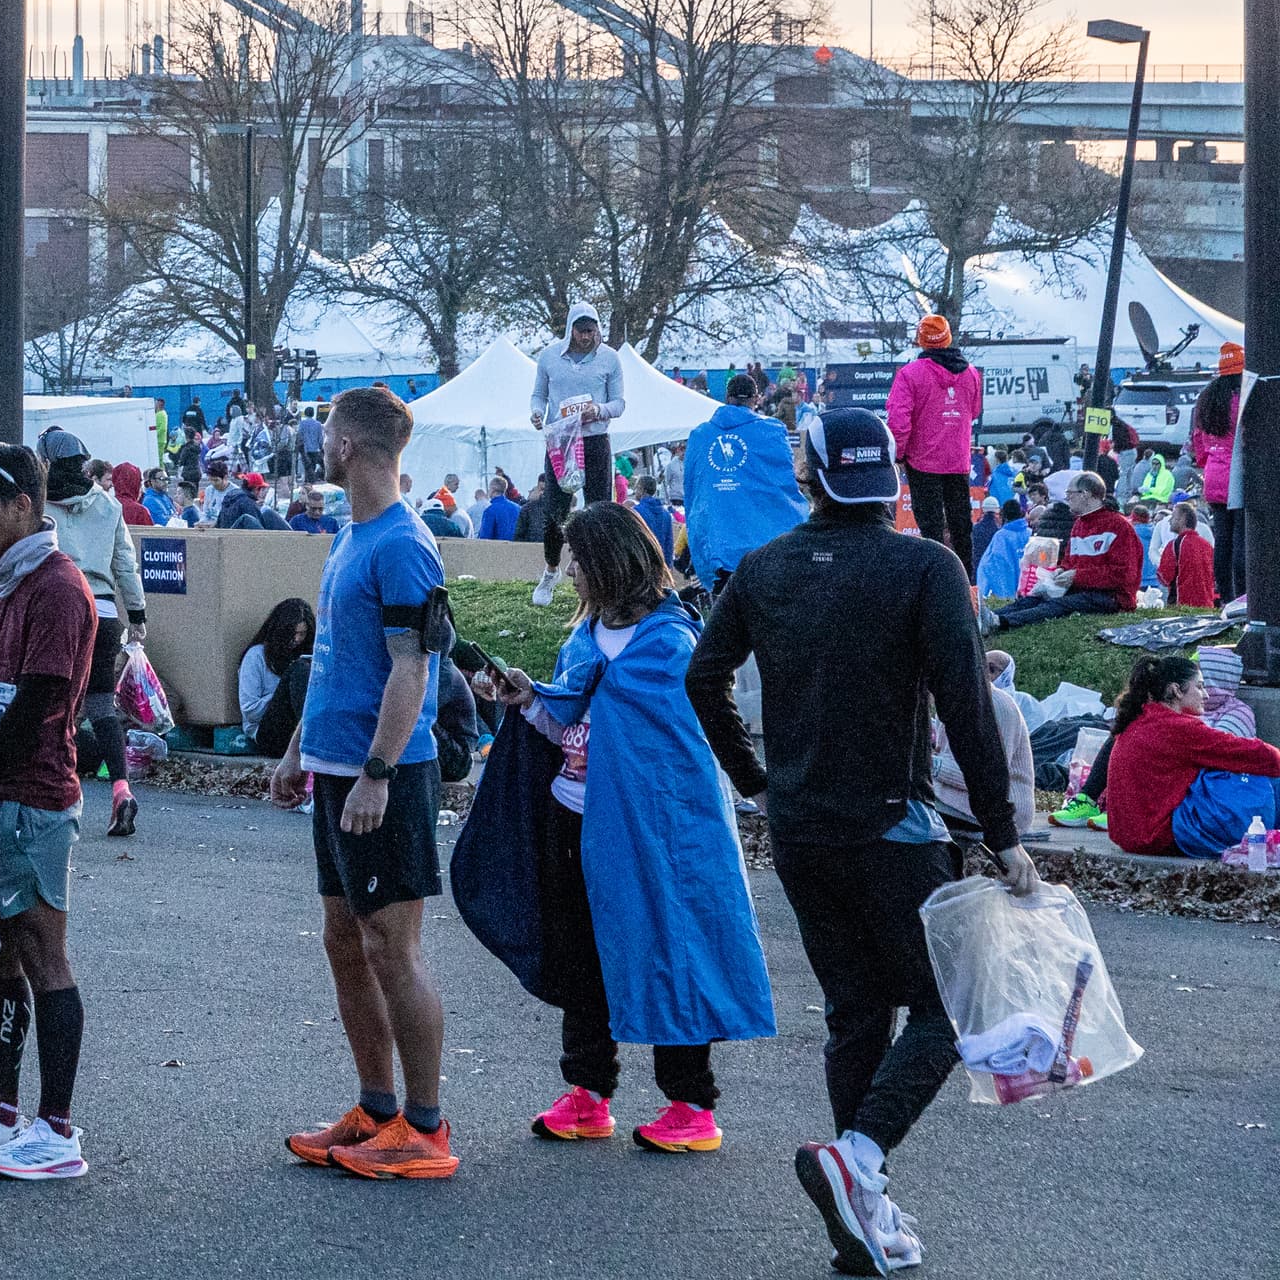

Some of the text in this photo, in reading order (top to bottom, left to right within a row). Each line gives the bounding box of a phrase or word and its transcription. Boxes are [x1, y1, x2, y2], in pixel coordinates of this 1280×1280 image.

[854, 371, 893, 380] Orange Village
[985, 377, 1026, 395] EWS
[1088, 416, 1108, 426] F10
[143, 551, 183, 563] CLOTHING
[143, 568, 184, 581] DONATION
